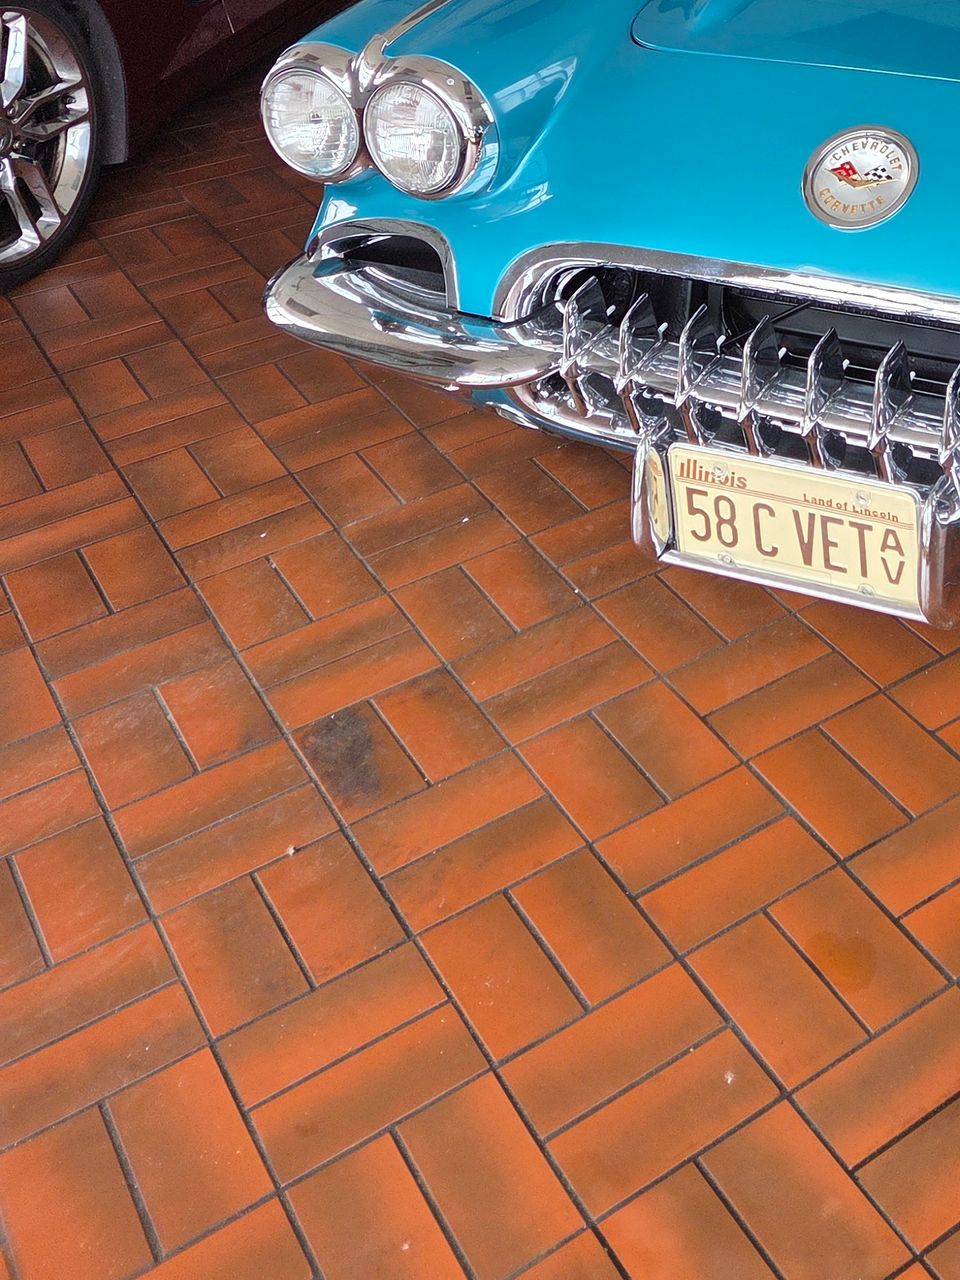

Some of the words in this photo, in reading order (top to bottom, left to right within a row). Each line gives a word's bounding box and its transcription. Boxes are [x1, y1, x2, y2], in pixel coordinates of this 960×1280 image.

[832, 140, 903, 171] CHEVROLET
[819, 187, 887, 216] CORVETTE
[803, 493, 833, 508] Land
[836, 502, 848, 512] of
[852, 504, 899, 523] Lincoln
[685, 486, 739, 549] 58
[752, 502, 779, 558] C
[791, 509, 873, 578] VET
